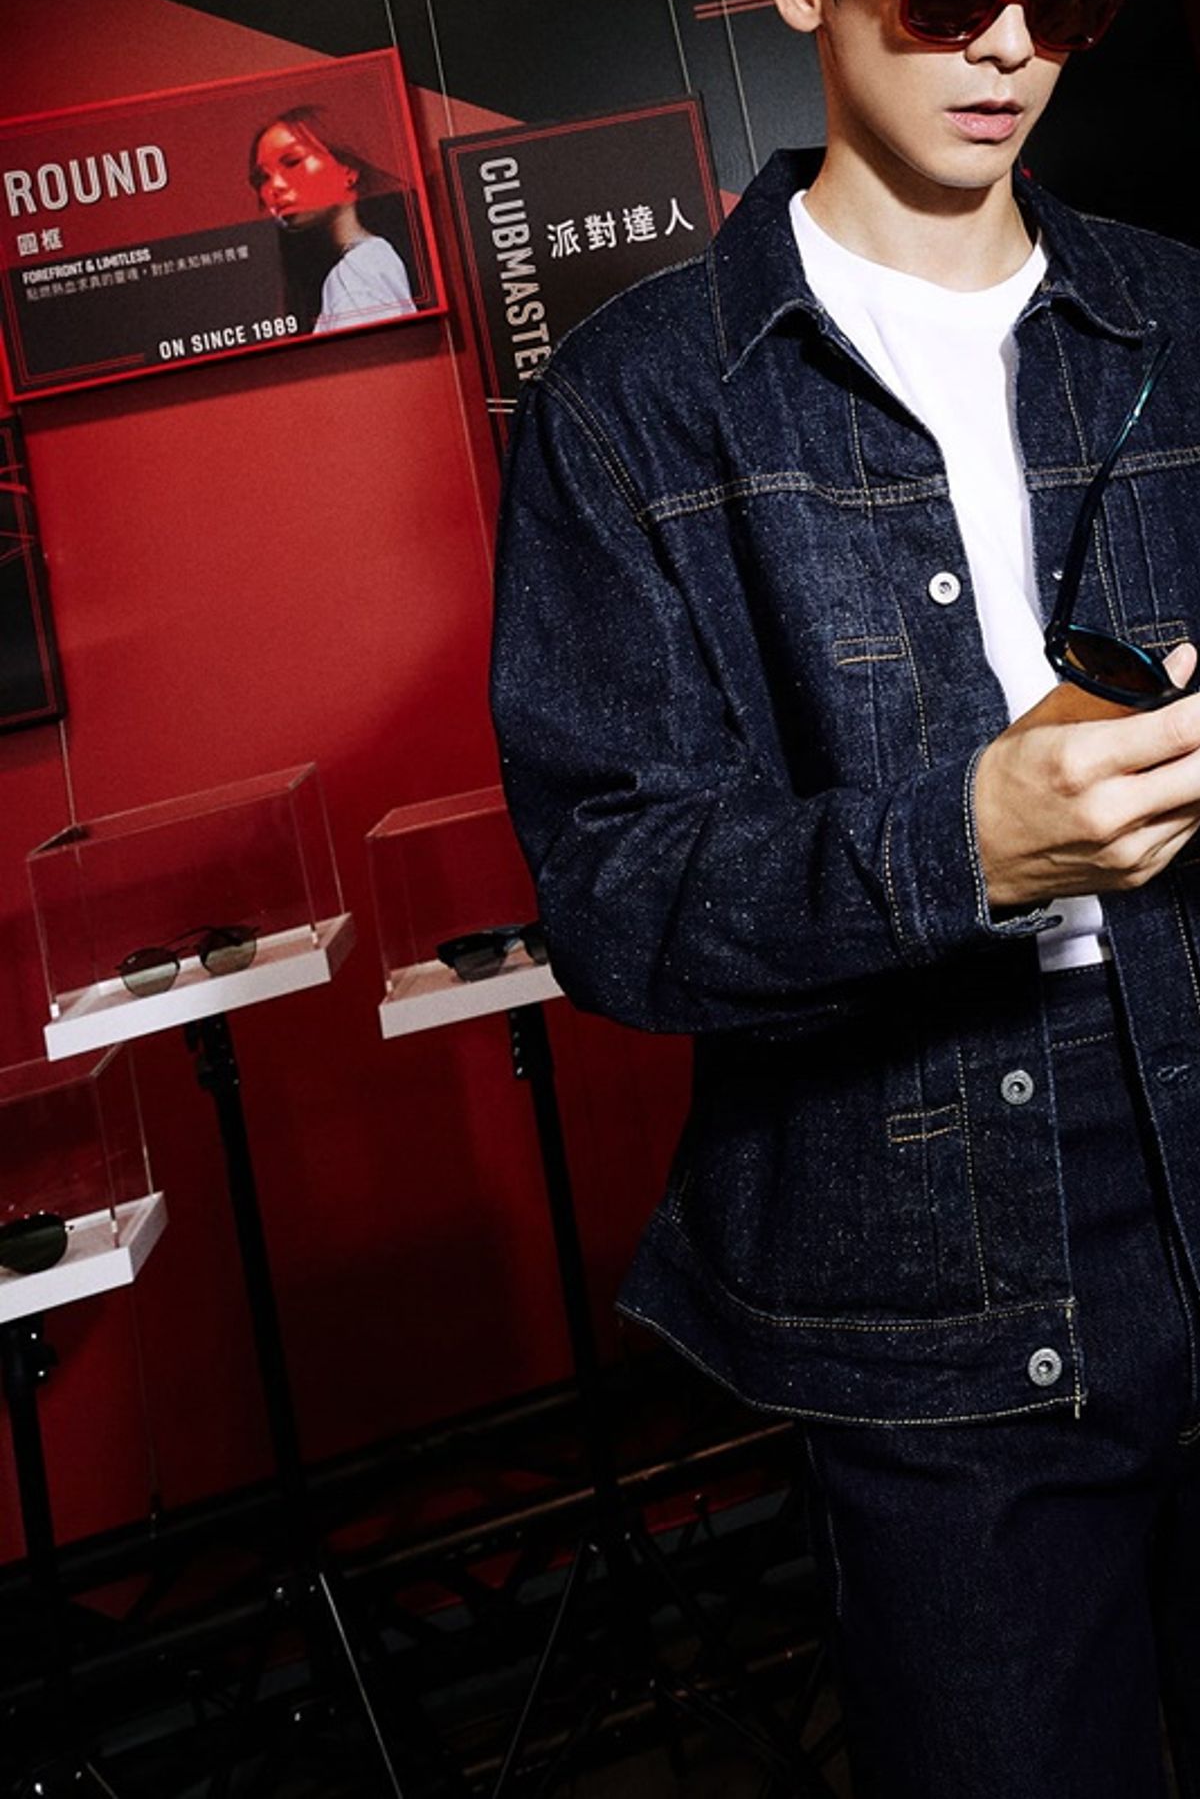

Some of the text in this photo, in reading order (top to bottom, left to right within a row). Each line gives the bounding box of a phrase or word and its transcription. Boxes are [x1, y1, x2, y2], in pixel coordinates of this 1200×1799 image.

[3, 144, 169, 217] ROUND
[546, 197, 695, 259] 派對達人
[22, 248, 152, 286] FOREFRONT & LIMITLESS
[158, 315, 299, 360] ON SINCE 1989
